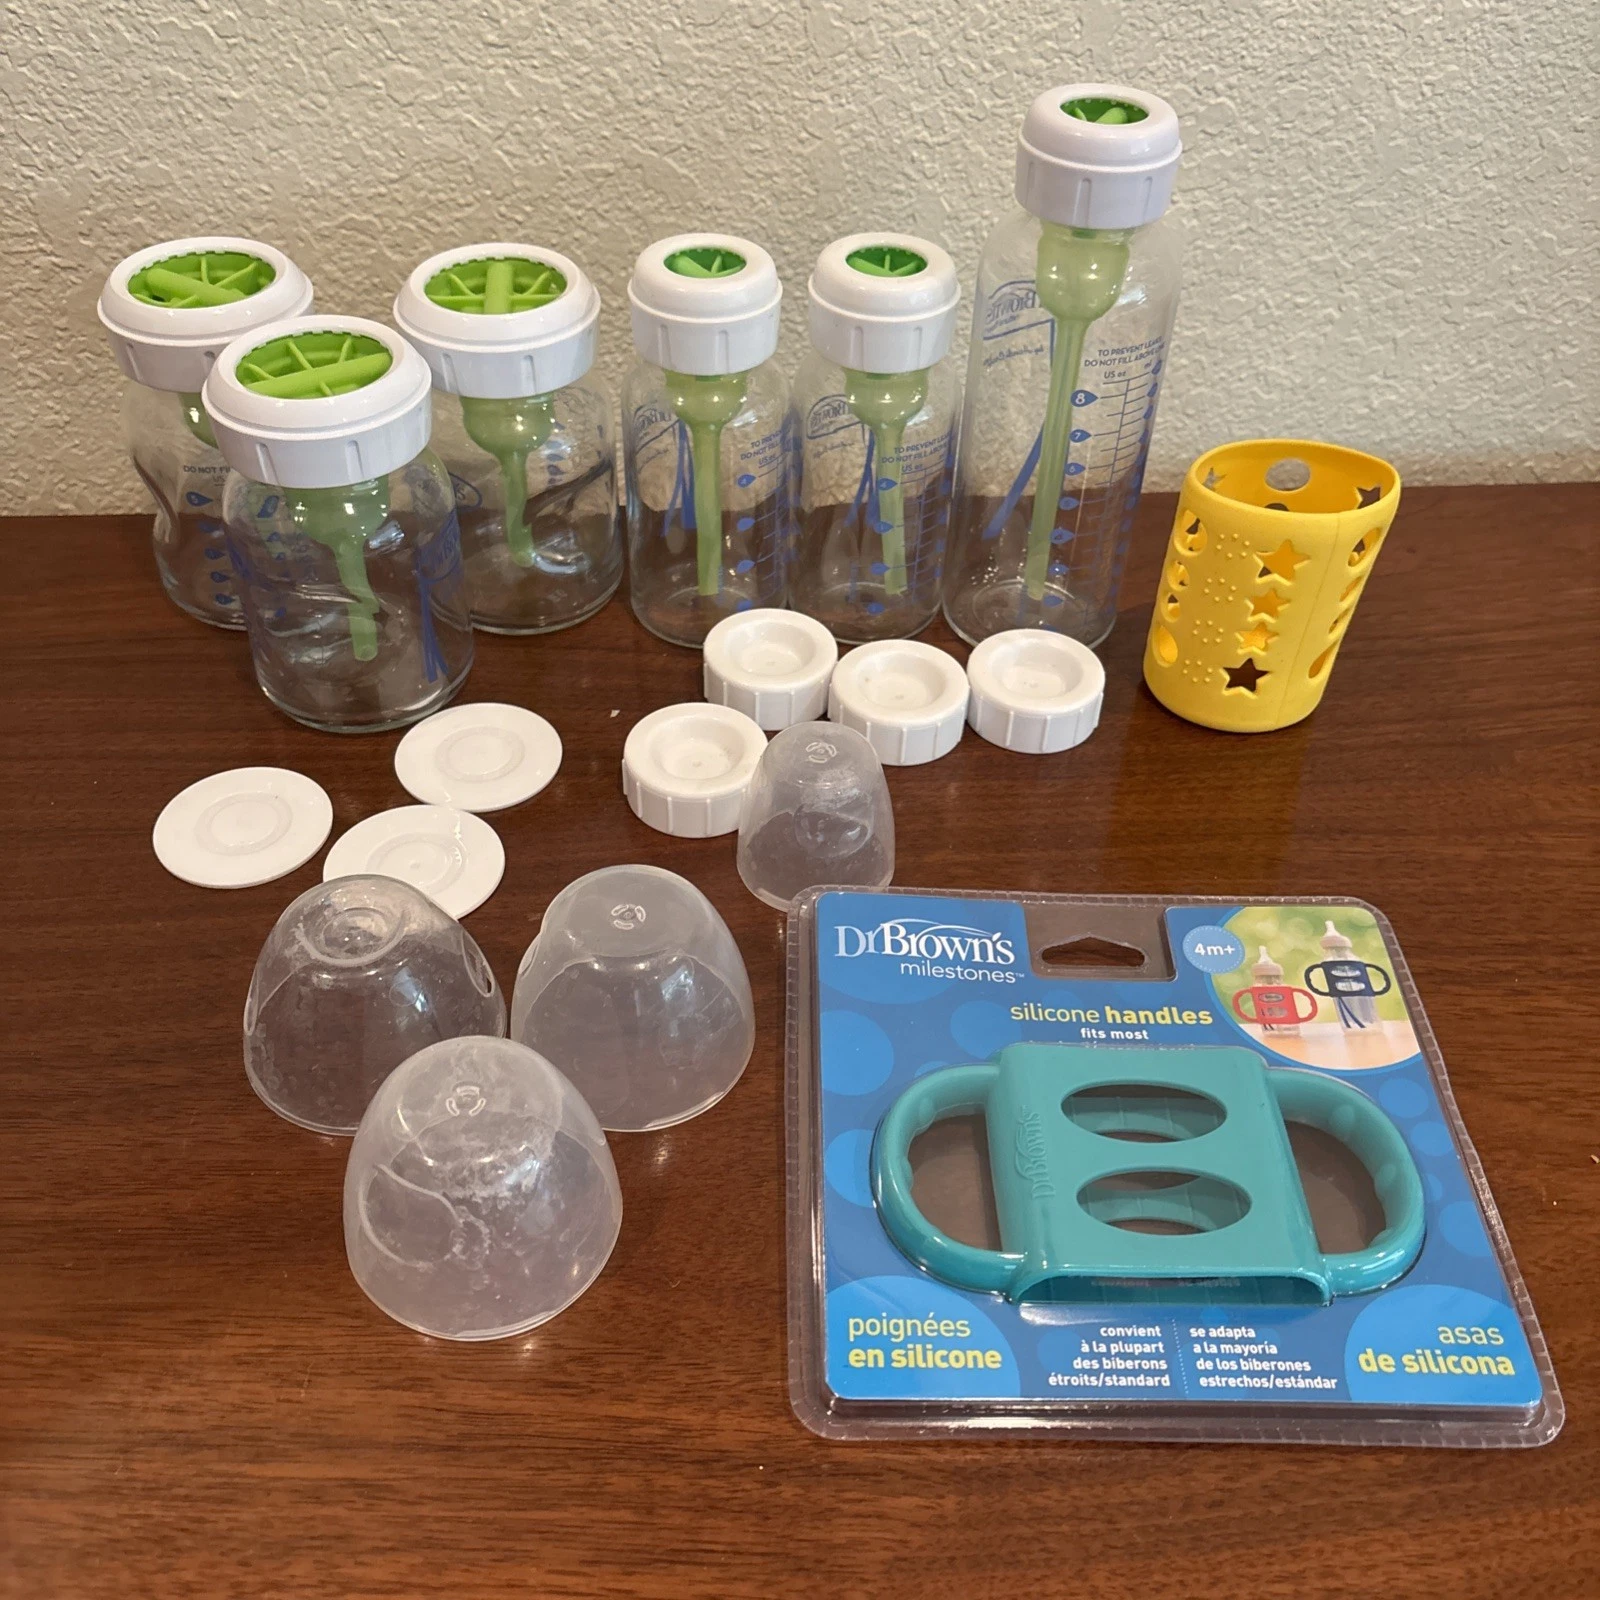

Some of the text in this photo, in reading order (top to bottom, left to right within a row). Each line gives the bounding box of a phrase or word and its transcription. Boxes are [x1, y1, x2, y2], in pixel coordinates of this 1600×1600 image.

[1097, 349, 1109, 357] TO
[1111, 343, 1143, 355] PREVENT
[1084, 359, 1098, 367] DO
[1100, 358, 1116, 367] NOT
[1118, 356, 1133, 365] FILL
[1103, 371, 1116, 379] US
[1075, 392, 1085, 404] 8
[1074, 432, 1081, 440] 7
[740, 452, 752, 460] DO
[895, 446, 905, 454] TO
[881, 456, 894, 464] DO
[183, 465, 196, 473] DO
[198, 466, 217, 474] NOT
[902, 464, 912, 472] US
[1194, 942, 1236, 956] 4m+
[1010, 1002, 1213, 1025] silicone handles
[1080, 1027, 1149, 1040] fits most
[848, 1312, 972, 1343] poignées
[1100, 1325, 1162, 1337] convient
[1189, 1325, 1256, 1340] se adapta
[1437, 1325, 1504, 1346] asas
[1080, 1339, 1165, 1356] à la plupart
[1193, 1341, 1278, 1357] a la mayoría
[848, 1343, 1003, 1369] en silicone
[1073, 1356, 1168, 1370] des biberons
[1358, 1347, 1516, 1376] de silicona
[1196, 1357, 1311, 1372] de los biberones
[1048, 1372, 1171, 1387] étroits/standard
[1199, 1373, 1338, 1389] estrechos/estándar
